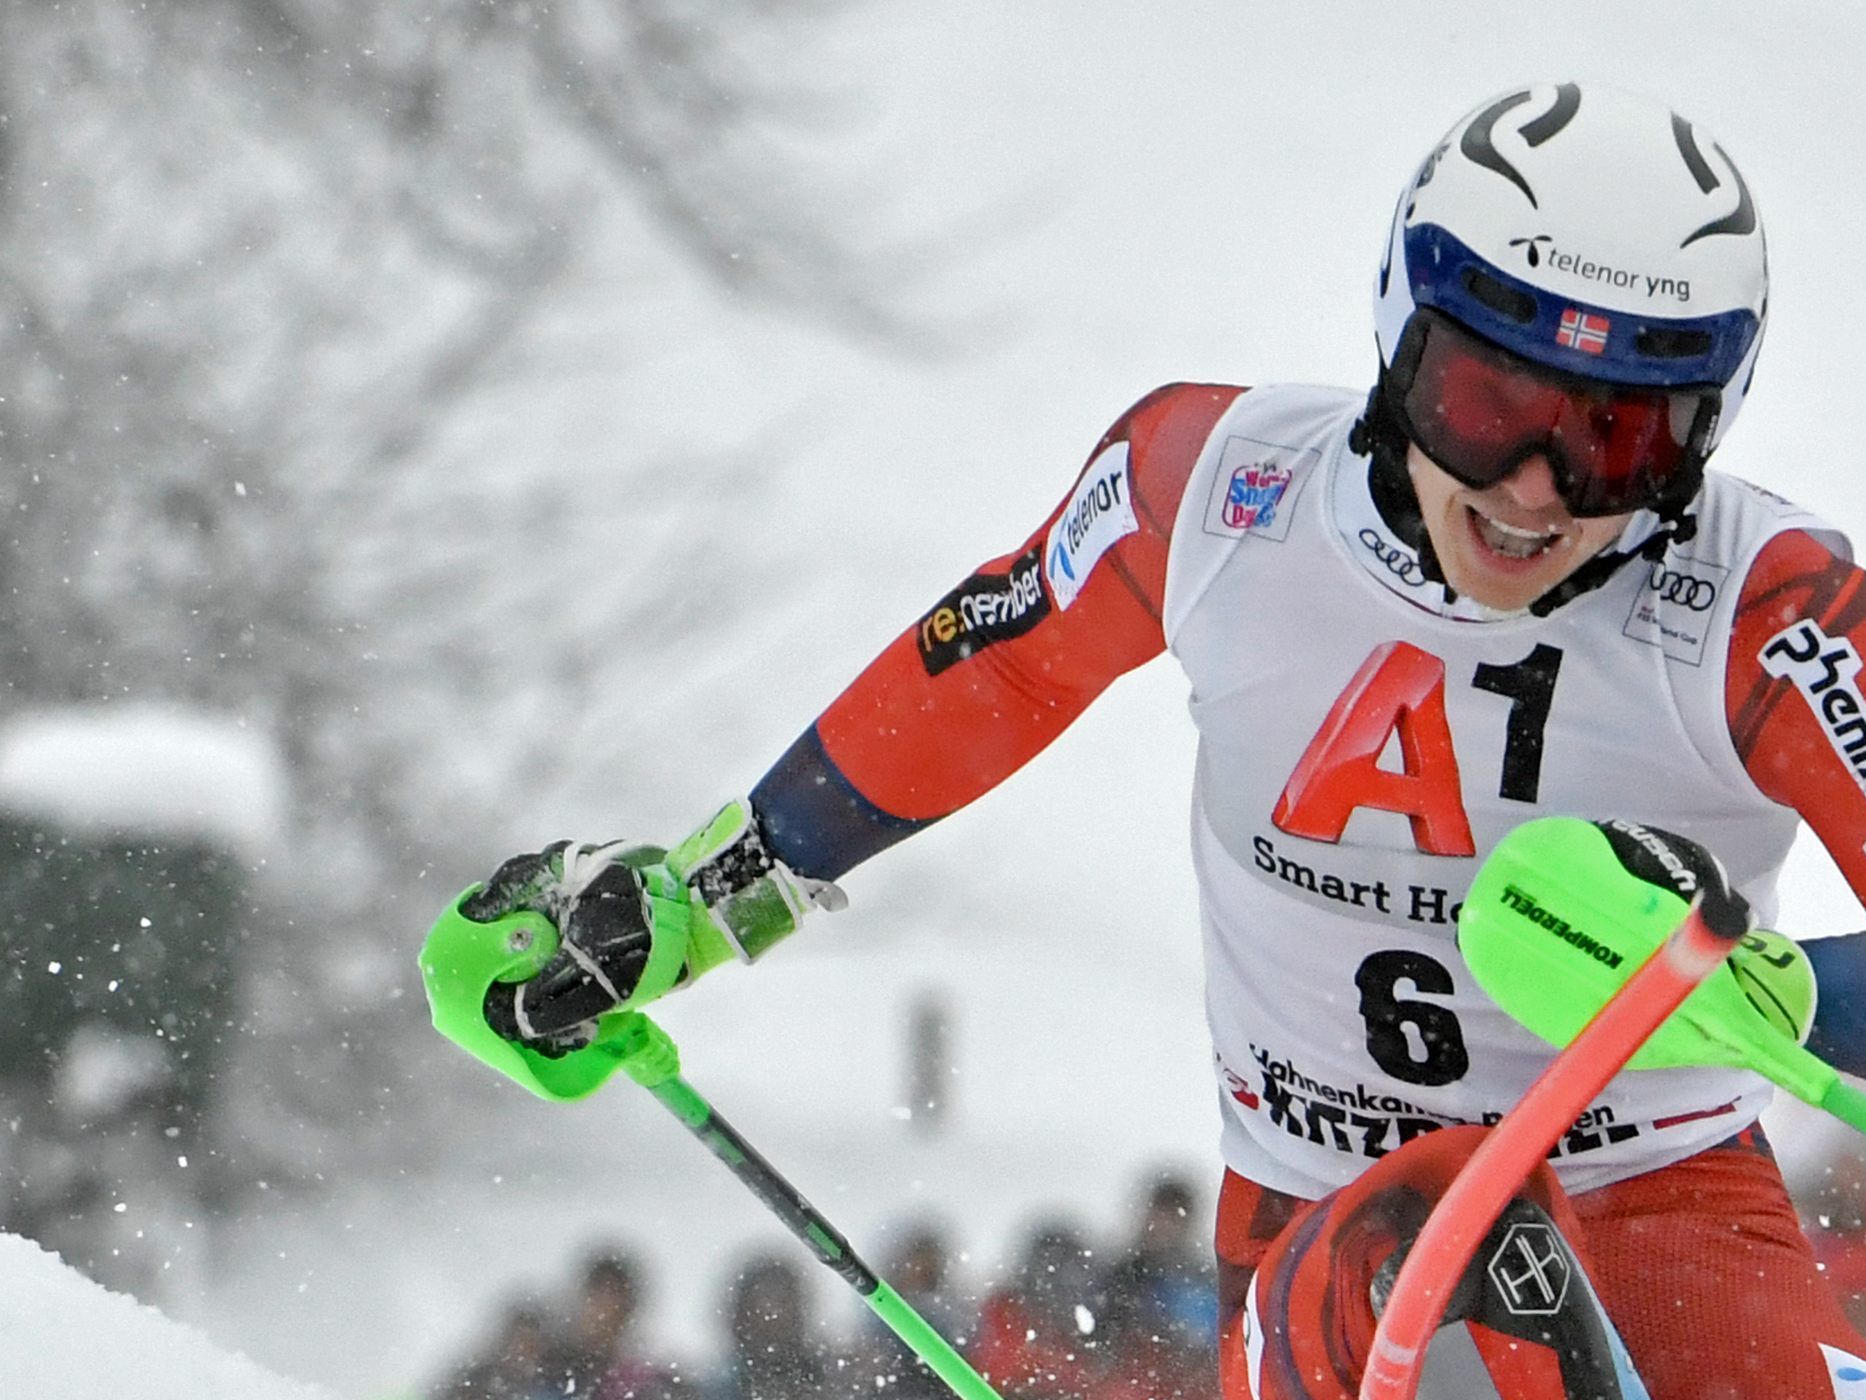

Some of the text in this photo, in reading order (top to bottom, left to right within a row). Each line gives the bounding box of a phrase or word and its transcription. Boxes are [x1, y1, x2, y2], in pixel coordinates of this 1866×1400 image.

[1548, 246, 1691, 302] telenor yng
[1066, 470, 1123, 555] telenor
[1252, 835, 1391, 915] Smart
[1500, 884, 1625, 970] KOMPERDELL
[1353, 948, 1470, 1088] 6
